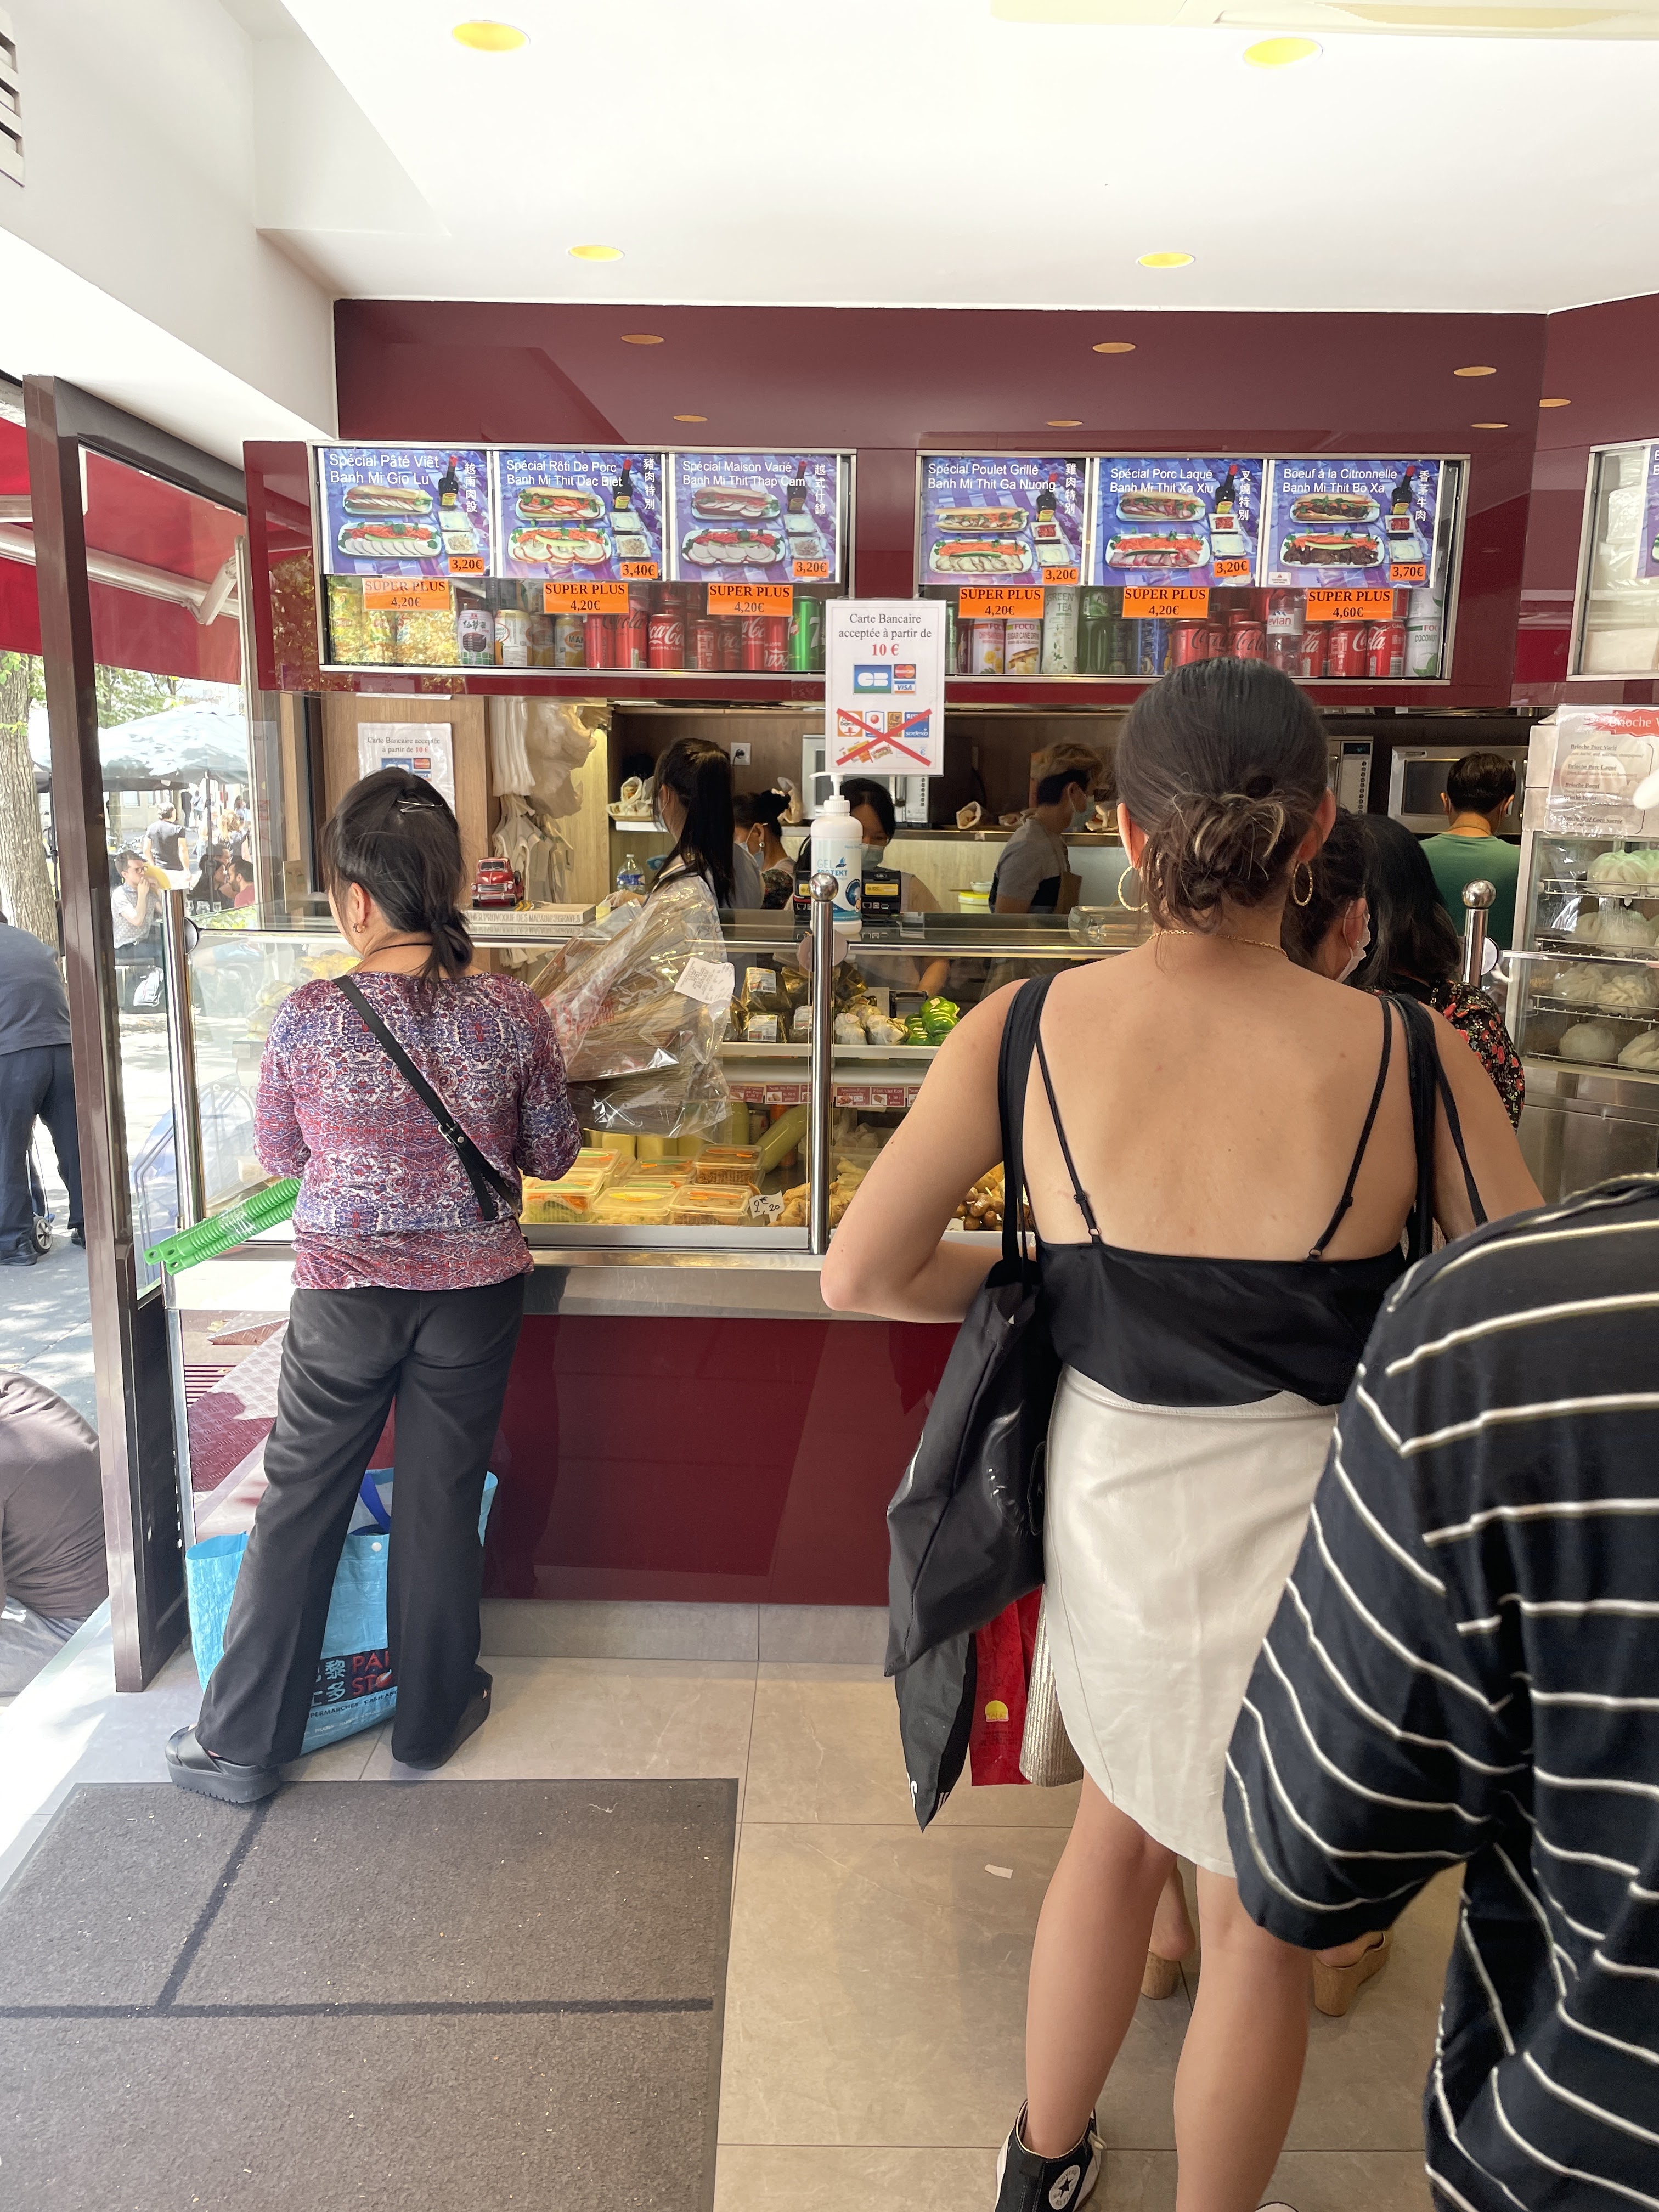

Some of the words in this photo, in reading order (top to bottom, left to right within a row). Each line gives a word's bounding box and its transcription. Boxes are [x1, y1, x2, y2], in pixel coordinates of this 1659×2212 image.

[330, 454, 376, 467] Spécial
[381, 454, 410, 467] Pâté
[414, 456, 439, 468] Viêt
[507, 460, 545, 471] Spécial
[549, 461, 570, 471] Rôti
[574, 462, 589, 471] De
[592, 462, 617, 472] Porc
[683, 461, 721, 472] Spécial
[724, 462, 761, 472] Maison
[764, 462, 792, 472] Varié
[928, 464, 968, 475] Spécial
[972, 464, 1007, 475] Poulet
[1010, 464, 1039, 475] Grillé
[1111, 469, 1149, 479] Spécial
[1153, 469, 1177, 479] Porc
[1180, 469, 1213, 481] Laqué
[1284, 469, 1316, 479] Boeuf
[1318, 470, 1324, 479] à
[1328, 469, 1337, 479] la
[1341, 469, 1397, 479] Citronnelle
[330, 471, 363, 483] Banh
[369, 472, 382, 483] Mi
[387, 472, 409, 484] Gio
[414, 473, 428, 484] Lu
[507, 475, 535, 484] Banh
[538, 475, 551, 485] Mi
[555, 476, 574, 486] Thit
[578, 476, 599, 486] Dac
[601, 476, 622, 487] Biet
[683, 475, 709, 484] Banh
[713, 475, 725, 486] Mi
[729, 476, 748, 486] Thit
[751, 476, 777, 488] Thap
[781, 476, 805, 487] Cam
[928, 478, 956, 489] Banh
[960, 479, 973, 489] Mi
[977, 479, 996, 489] Thit
[1000, 479, 1016, 489] Ga
[1020, 480, 1056, 492] Nuong
[1110, 482, 1138, 493] Banh
[1141, 482, 1153, 493] Mi
[1156, 482, 1176, 493] Thit
[1179, 483, 1193, 493] Xa
[1196, 483, 1214, 493] Xiu
[1283, 484, 1311, 493] Banh
[1314, 484, 1326, 493] Mi
[1330, 484, 1349, 493] Thit
[1352, 484, 1367, 493] Bo
[1370, 483, 1385, 493] Xa
[452, 559, 482, 570] 3,20€
[796, 562, 827, 573] 3,20€
[1216, 561, 1248, 573] 3,20€
[623, 565, 655, 576] 3,40€
[1046, 569, 1076, 582] 3,20€
[1392, 567, 1424, 578] 3,70€
[365, 581, 410, 591] SUPER
[413, 582, 445, 591] PLUS
[545, 584, 588, 594] SUPER
[591, 584, 625, 594] PLUS
[710, 585, 752, 596] SUPER
[757, 586, 789, 597] PLUS
[961, 589, 1003, 599] SUPER
[1007, 589, 1041, 600] PLUS
[1047, 592, 1074, 601] GREEN
[1125, 589, 1167, 599] SUPER
[1172, 589, 1205, 599] PLUS
[1309, 591, 1351, 601] SUPER
[1356, 591, 1390, 601] PLUS
[391, 597, 421, 608] 4,20€
[571, 600, 600, 612] 4,20€
[735, 602, 764, 613] 4,20€
[1057, 603, 1072, 612] TEA
[985, 605, 1014, 617] 4,20€
[1149, 605, 1179, 617] 4,20€
[1333, 607, 1363, 619] 4,60€
[850, 613, 876, 623] Carte
[879, 614, 921, 623] Bancaire
[1268, 616, 1291, 627] evian
[839, 628, 880, 640] acceptée
[883, 628, 888, 637] à
[891, 629, 917, 640] partir
[921, 629, 932, 638] de
[872, 644, 887, 656] 10
[891, 644, 899, 656] €
[817, 859, 835, 869] GEL
